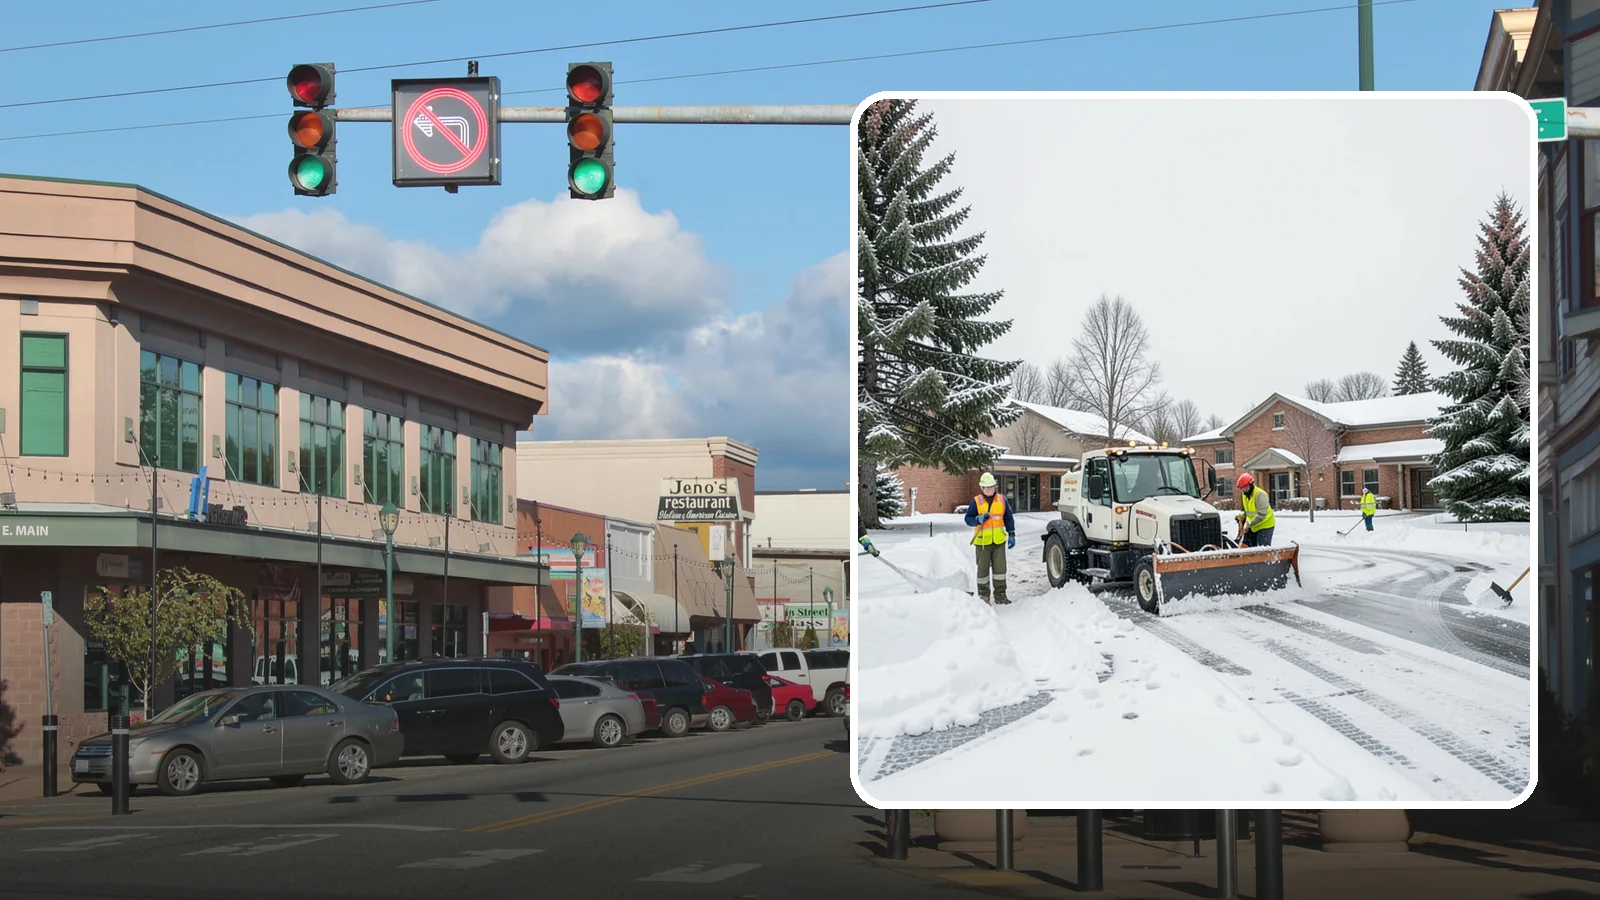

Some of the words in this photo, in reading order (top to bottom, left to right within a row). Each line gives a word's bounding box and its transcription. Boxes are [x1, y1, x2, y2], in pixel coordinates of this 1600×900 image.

[670, 480, 727, 494] Jeno's
[665, 496, 731, 509] restaurant
[658, 509, 681, 519] Italian
[685, 509, 714, 519] American
[714, 509, 738, 519] Cuisine
[2, 525, 13, 536] E.
[15, 525, 49, 536] MAIN
[797, 607, 829, 617] Street
[790, 619, 823, 627] lass
